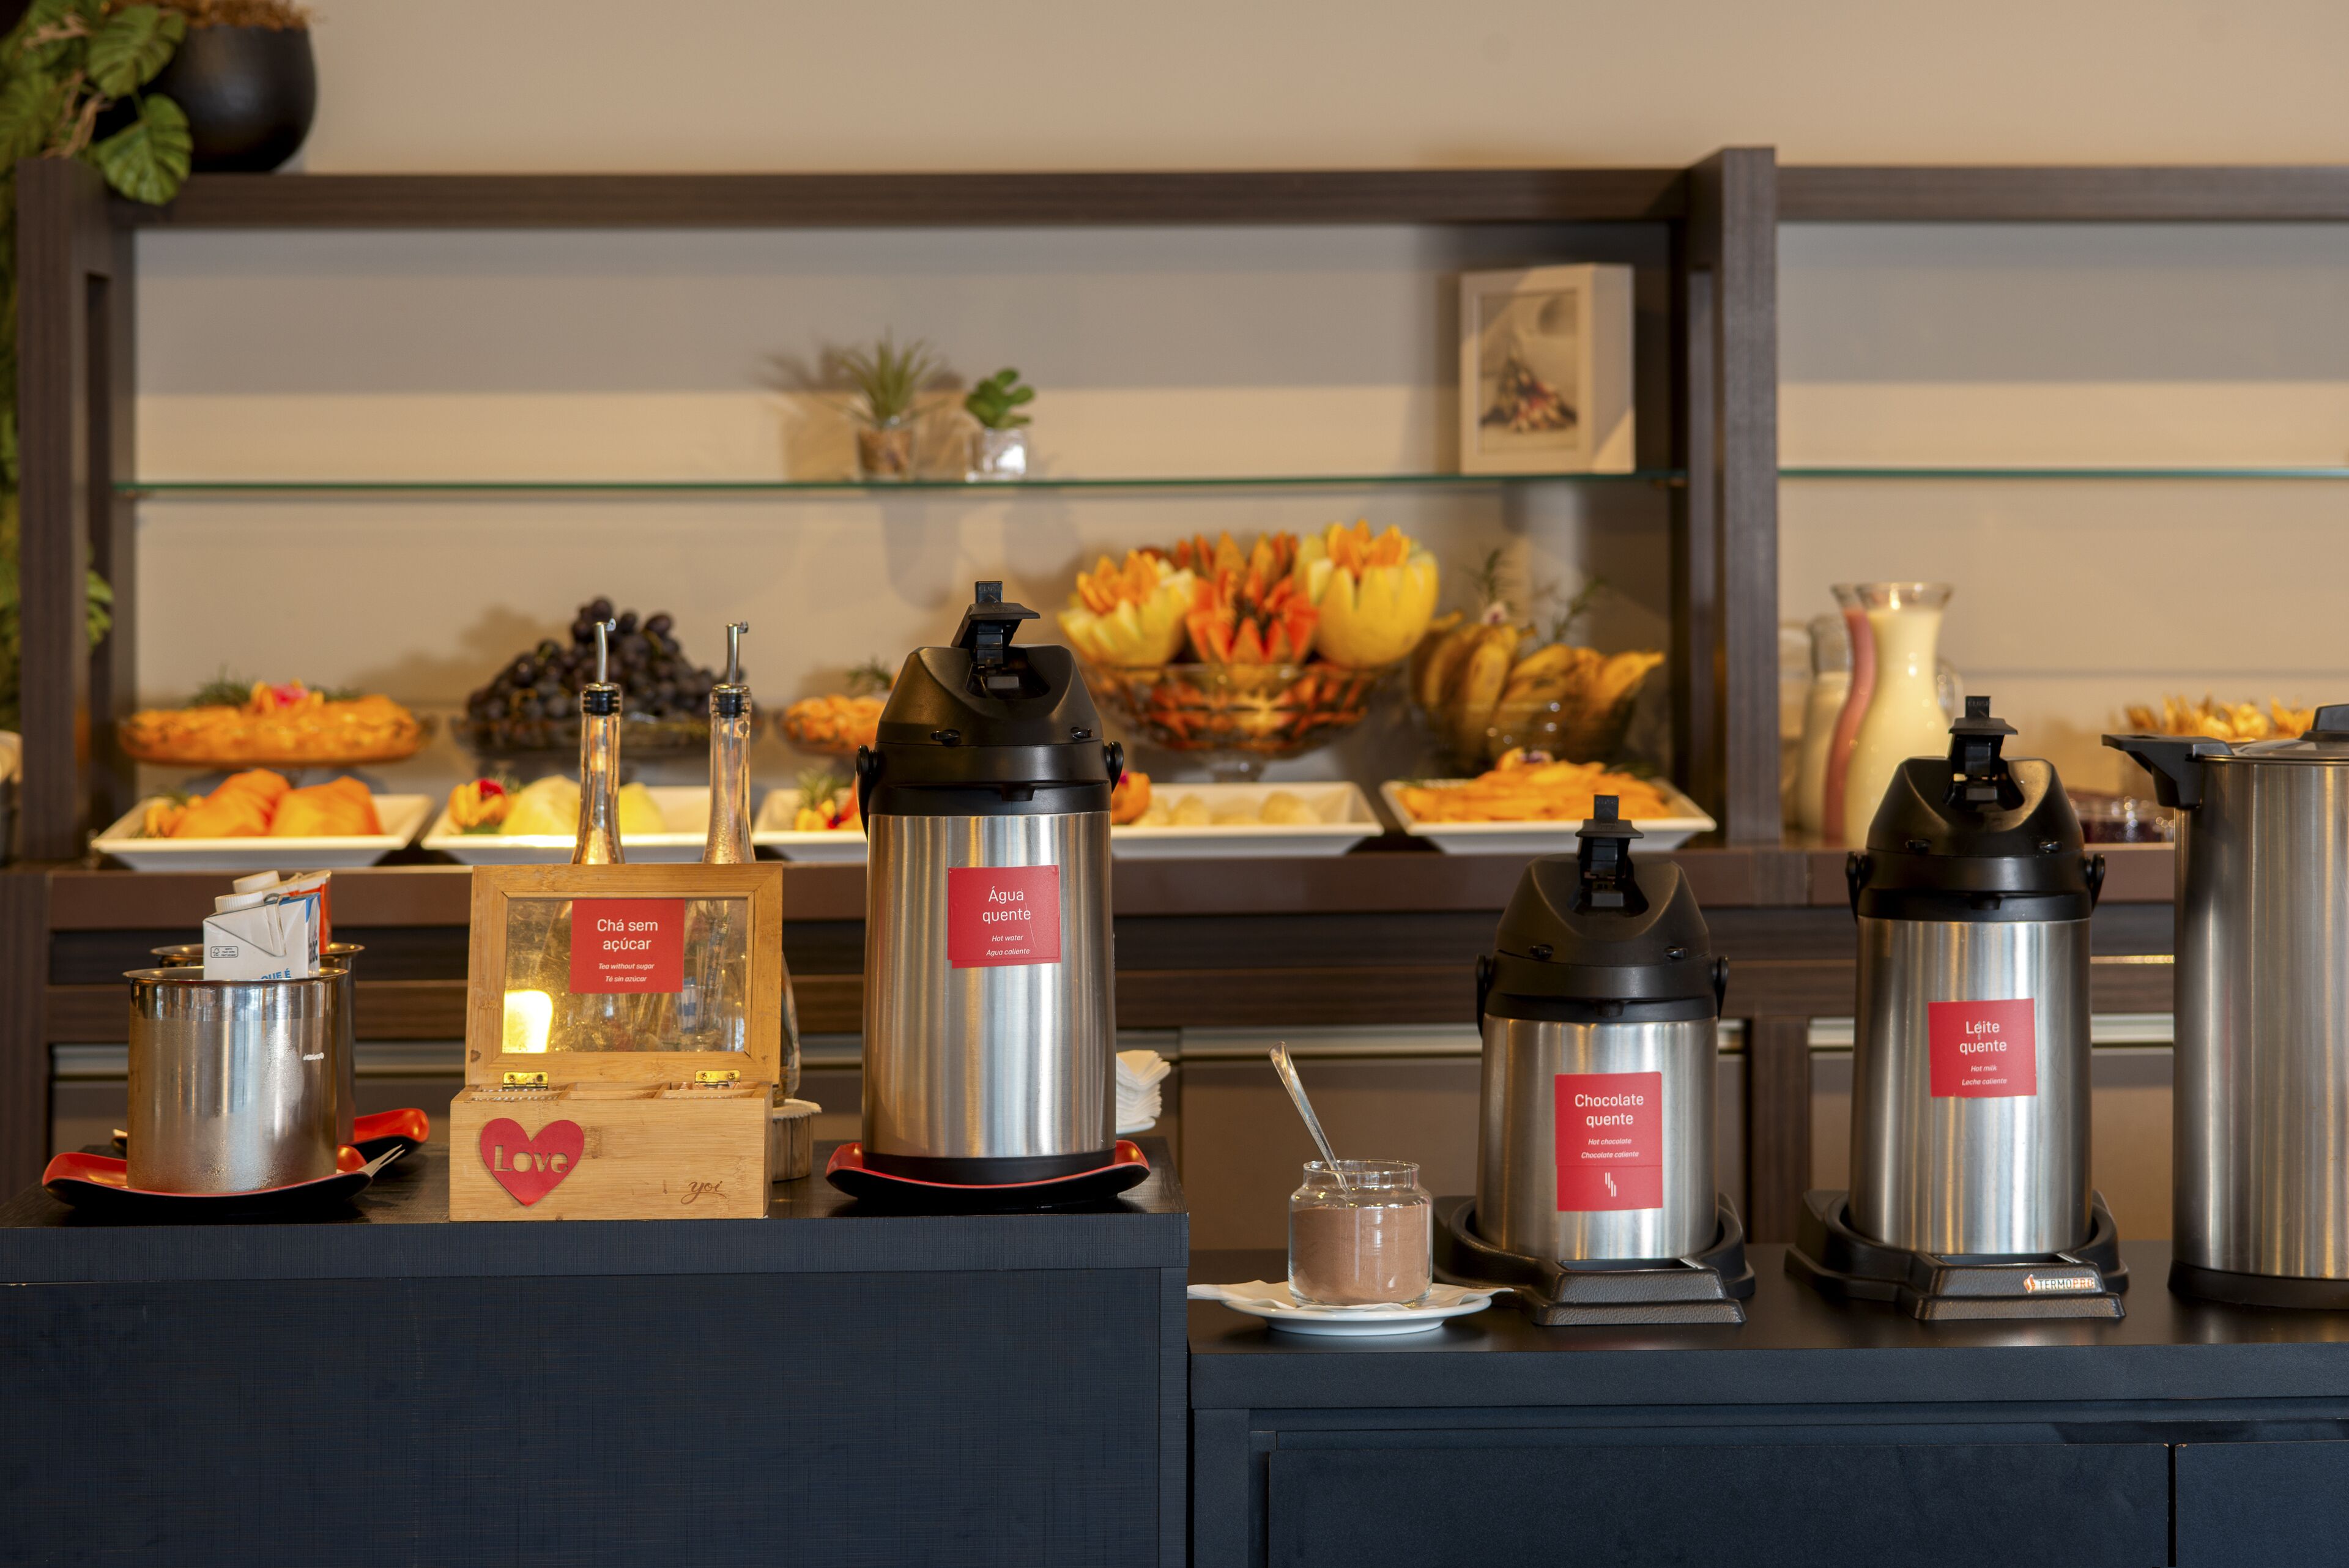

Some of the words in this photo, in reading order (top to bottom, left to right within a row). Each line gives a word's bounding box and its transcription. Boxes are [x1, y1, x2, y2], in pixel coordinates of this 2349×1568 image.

[988, 885, 1023, 904] Água
[982, 908, 1030, 924] quente
[597, 918, 624, 931] Chá
[628, 922, 658, 931] sem
[603, 937, 651, 952] açúcar
[1965, 1020, 1999, 1034] Leite
[1959, 1040, 2006, 1055] quente
[1575, 1093, 1643, 1107] Chocolate
[1586, 1113, 1633, 1128] quente
[494, 1145, 568, 1173] Love
[2038, 1278, 2095, 1290] TERMOPRO
